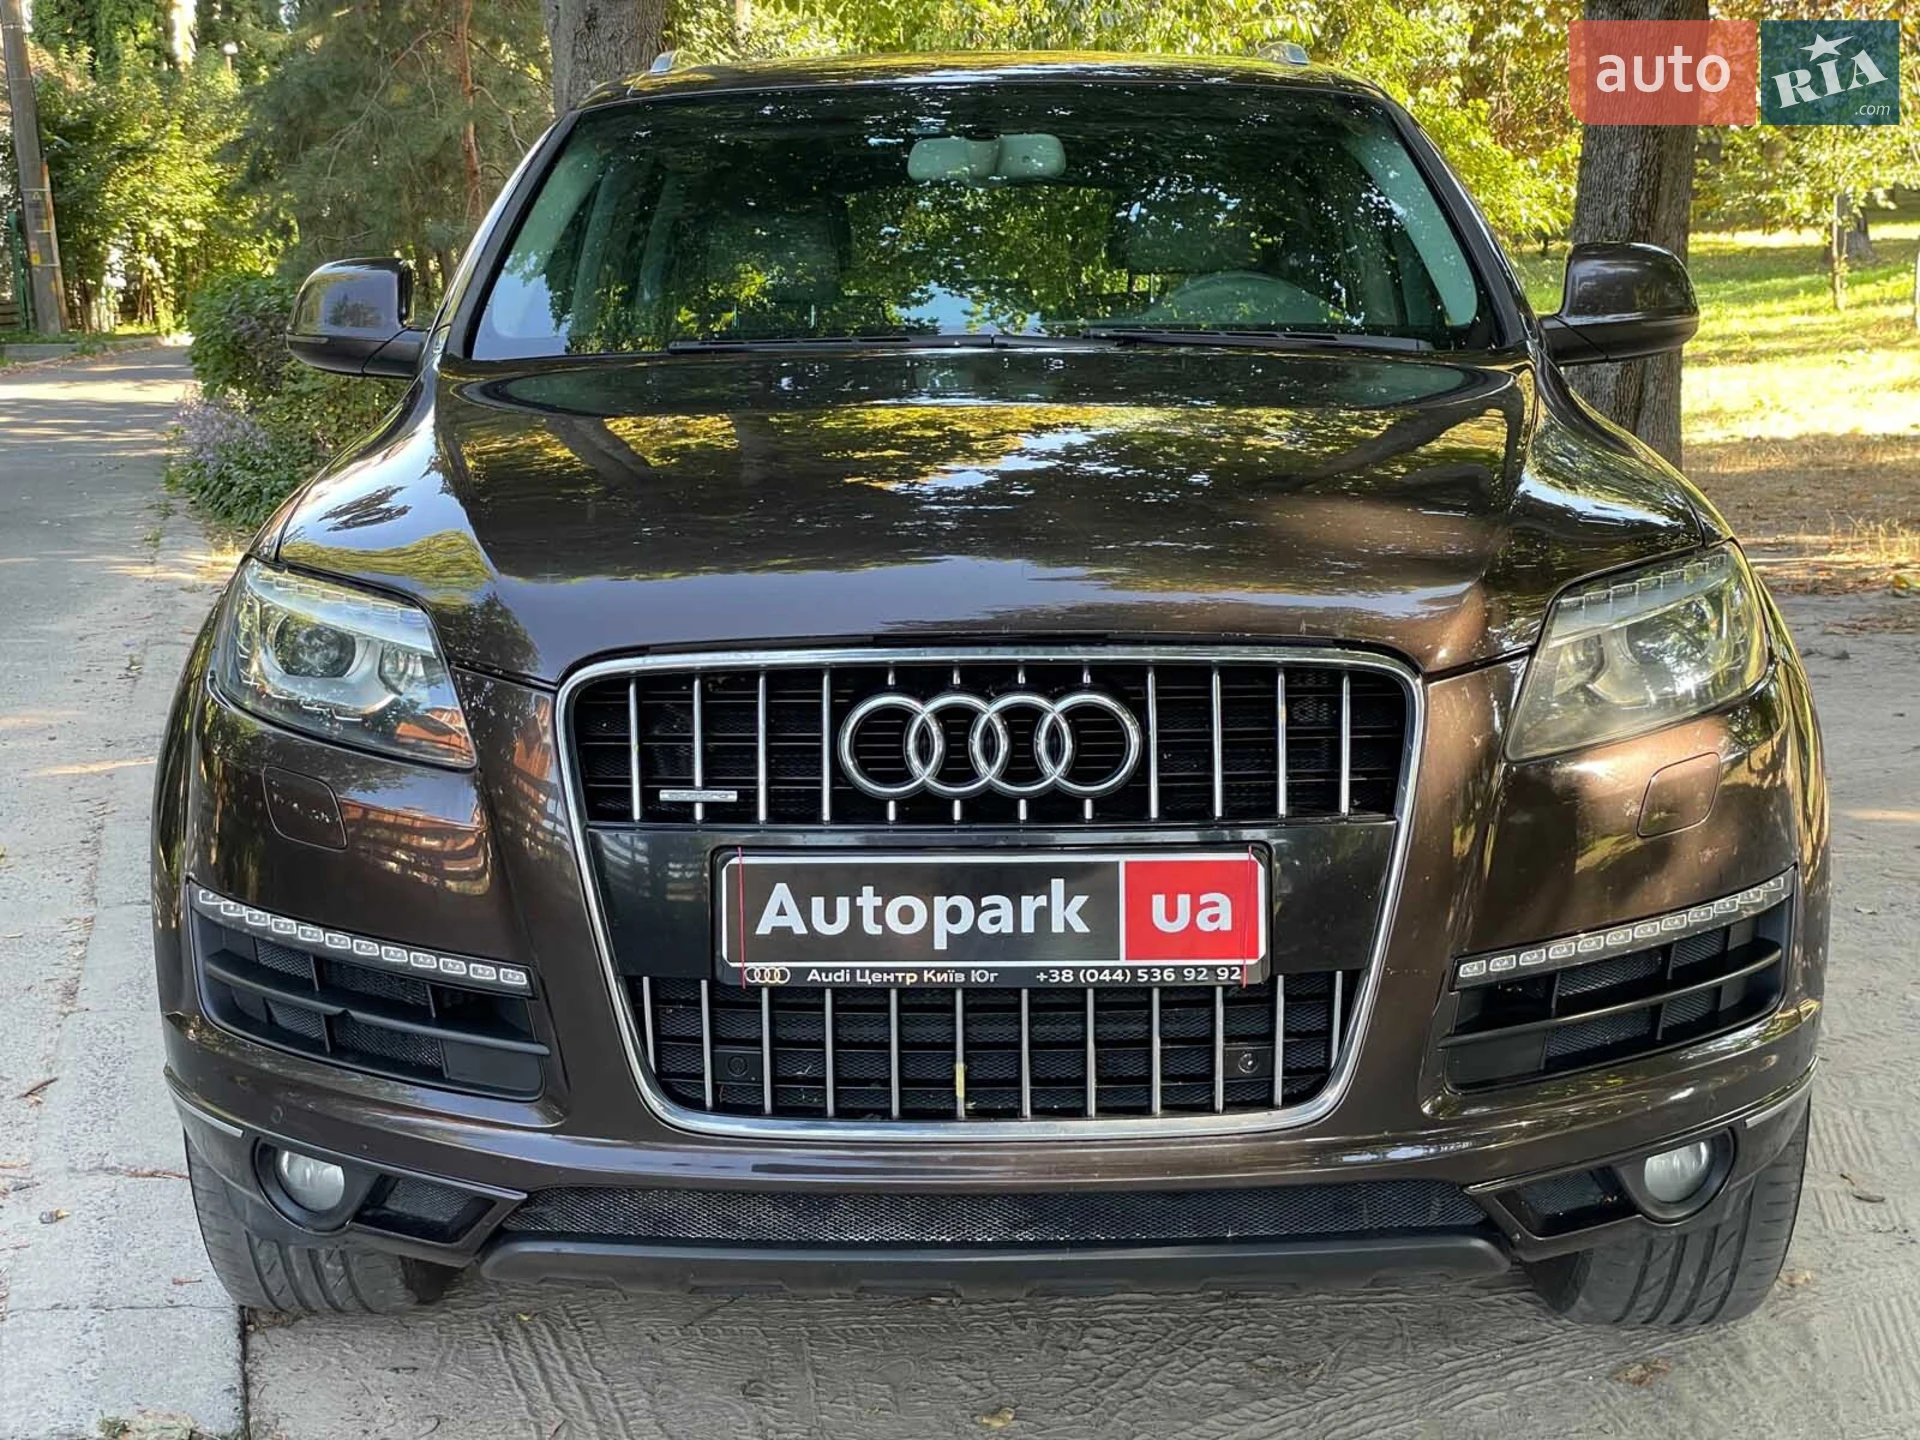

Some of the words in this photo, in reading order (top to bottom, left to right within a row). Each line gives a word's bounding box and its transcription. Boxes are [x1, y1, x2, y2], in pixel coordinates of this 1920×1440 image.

[755, 878, 1090, 950] Autopark
[1151, 890, 1233, 932] ua
[807, 968, 850, 983] Audi
[854, 968, 918, 985] Центр
[922, 967, 965, 983] Київ
[970, 968, 999, 984] Юг
[1035, 968, 1074, 983] +38
[1078, 967, 1131, 984] (044)
[1136, 967, 1176, 982] 536
[1183, 967, 1209, 982] 92
[1216, 966, 1242, 981] 92
